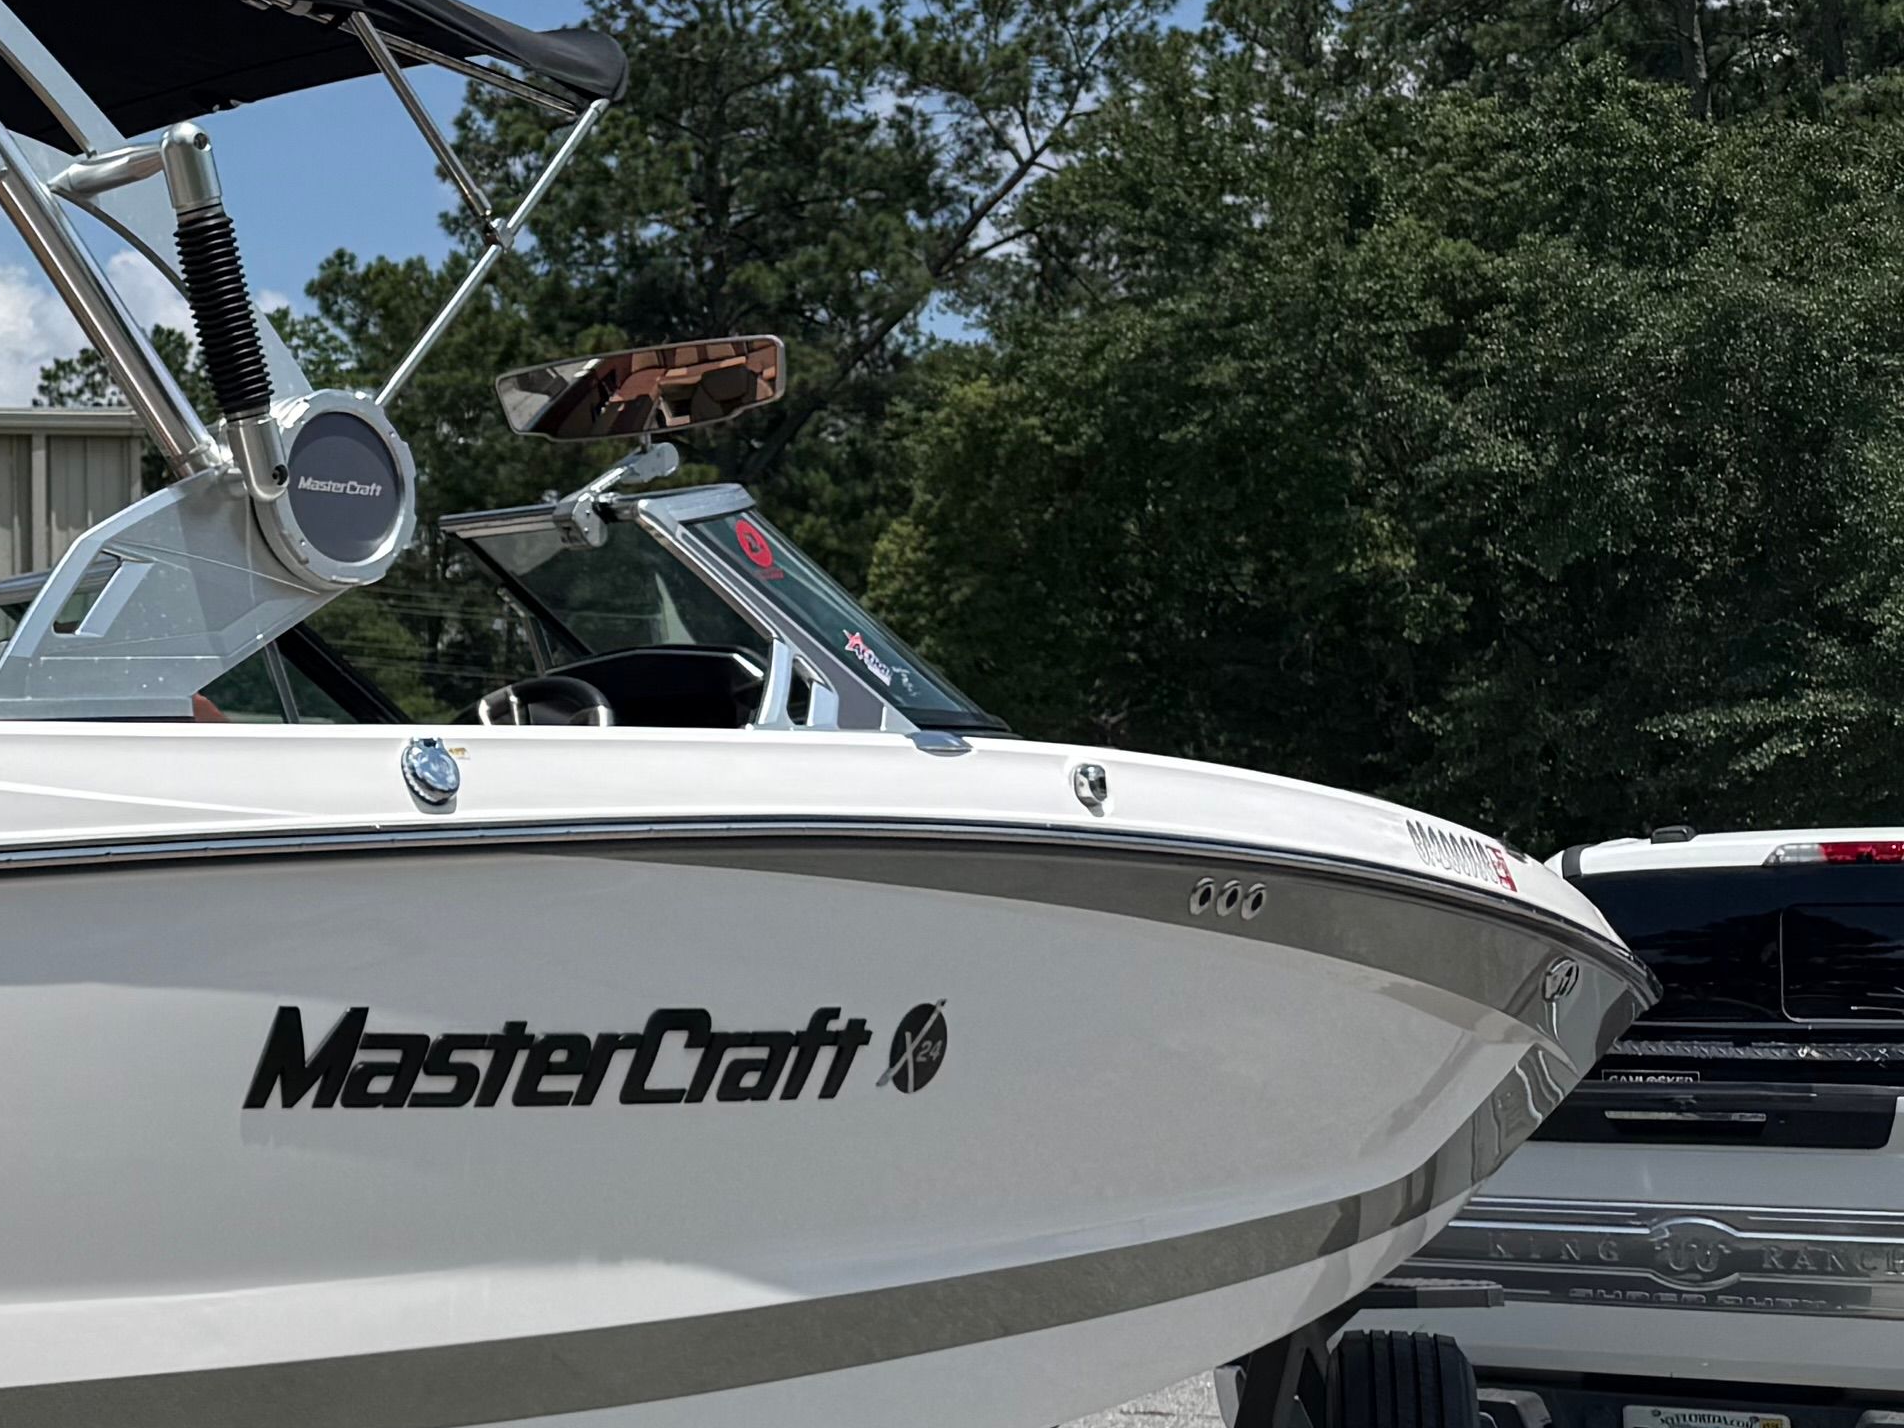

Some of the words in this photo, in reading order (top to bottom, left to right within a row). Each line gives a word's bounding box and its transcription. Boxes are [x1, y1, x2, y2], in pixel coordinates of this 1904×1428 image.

[297, 475, 383, 498] MasterCraft
[241, 1005, 874, 1110] MasterCraft
[1488, 1232, 1620, 1262] KING
